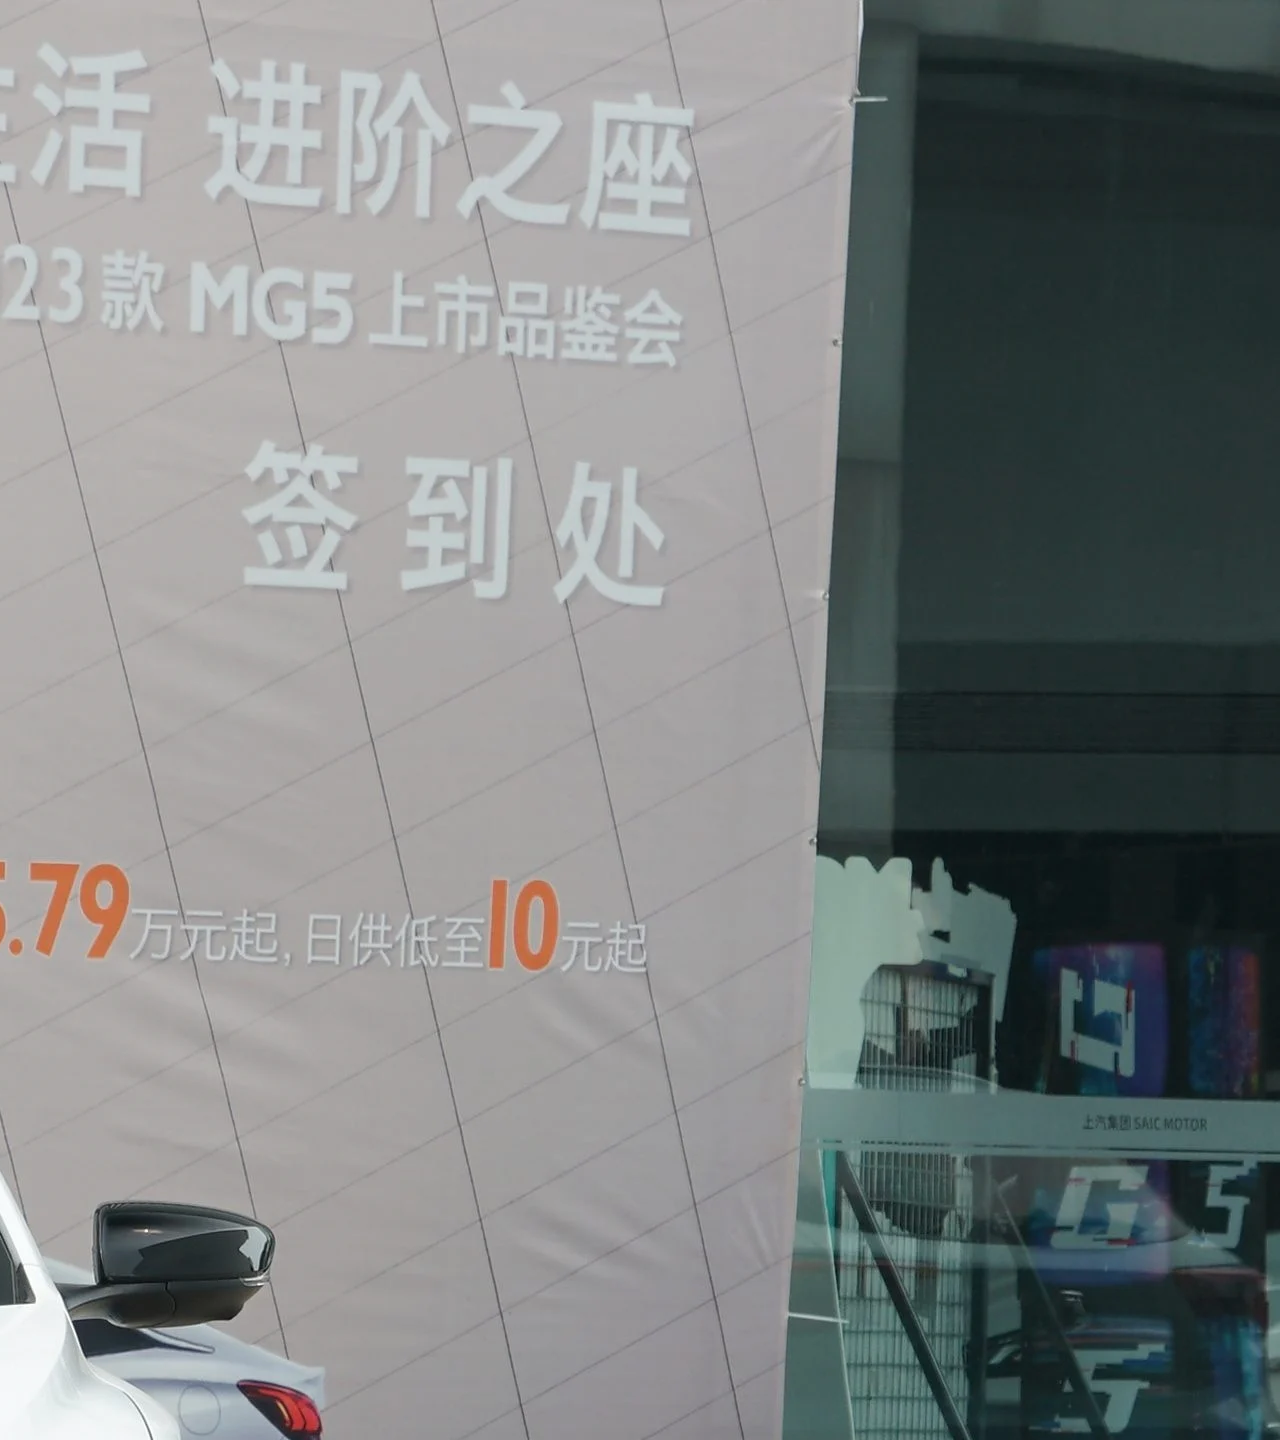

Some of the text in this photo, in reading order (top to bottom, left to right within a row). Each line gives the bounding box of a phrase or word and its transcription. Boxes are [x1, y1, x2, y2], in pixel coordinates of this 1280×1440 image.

[204, 58, 696, 237] 进阶之座
[189, 260, 355, 346] MG5
[368, 272, 684, 370] 上市品鉴会
[241, 440, 668, 608] 签到处
[1083, 1113, 1208, 1131] 上汽集团 SAIC MOTOR
